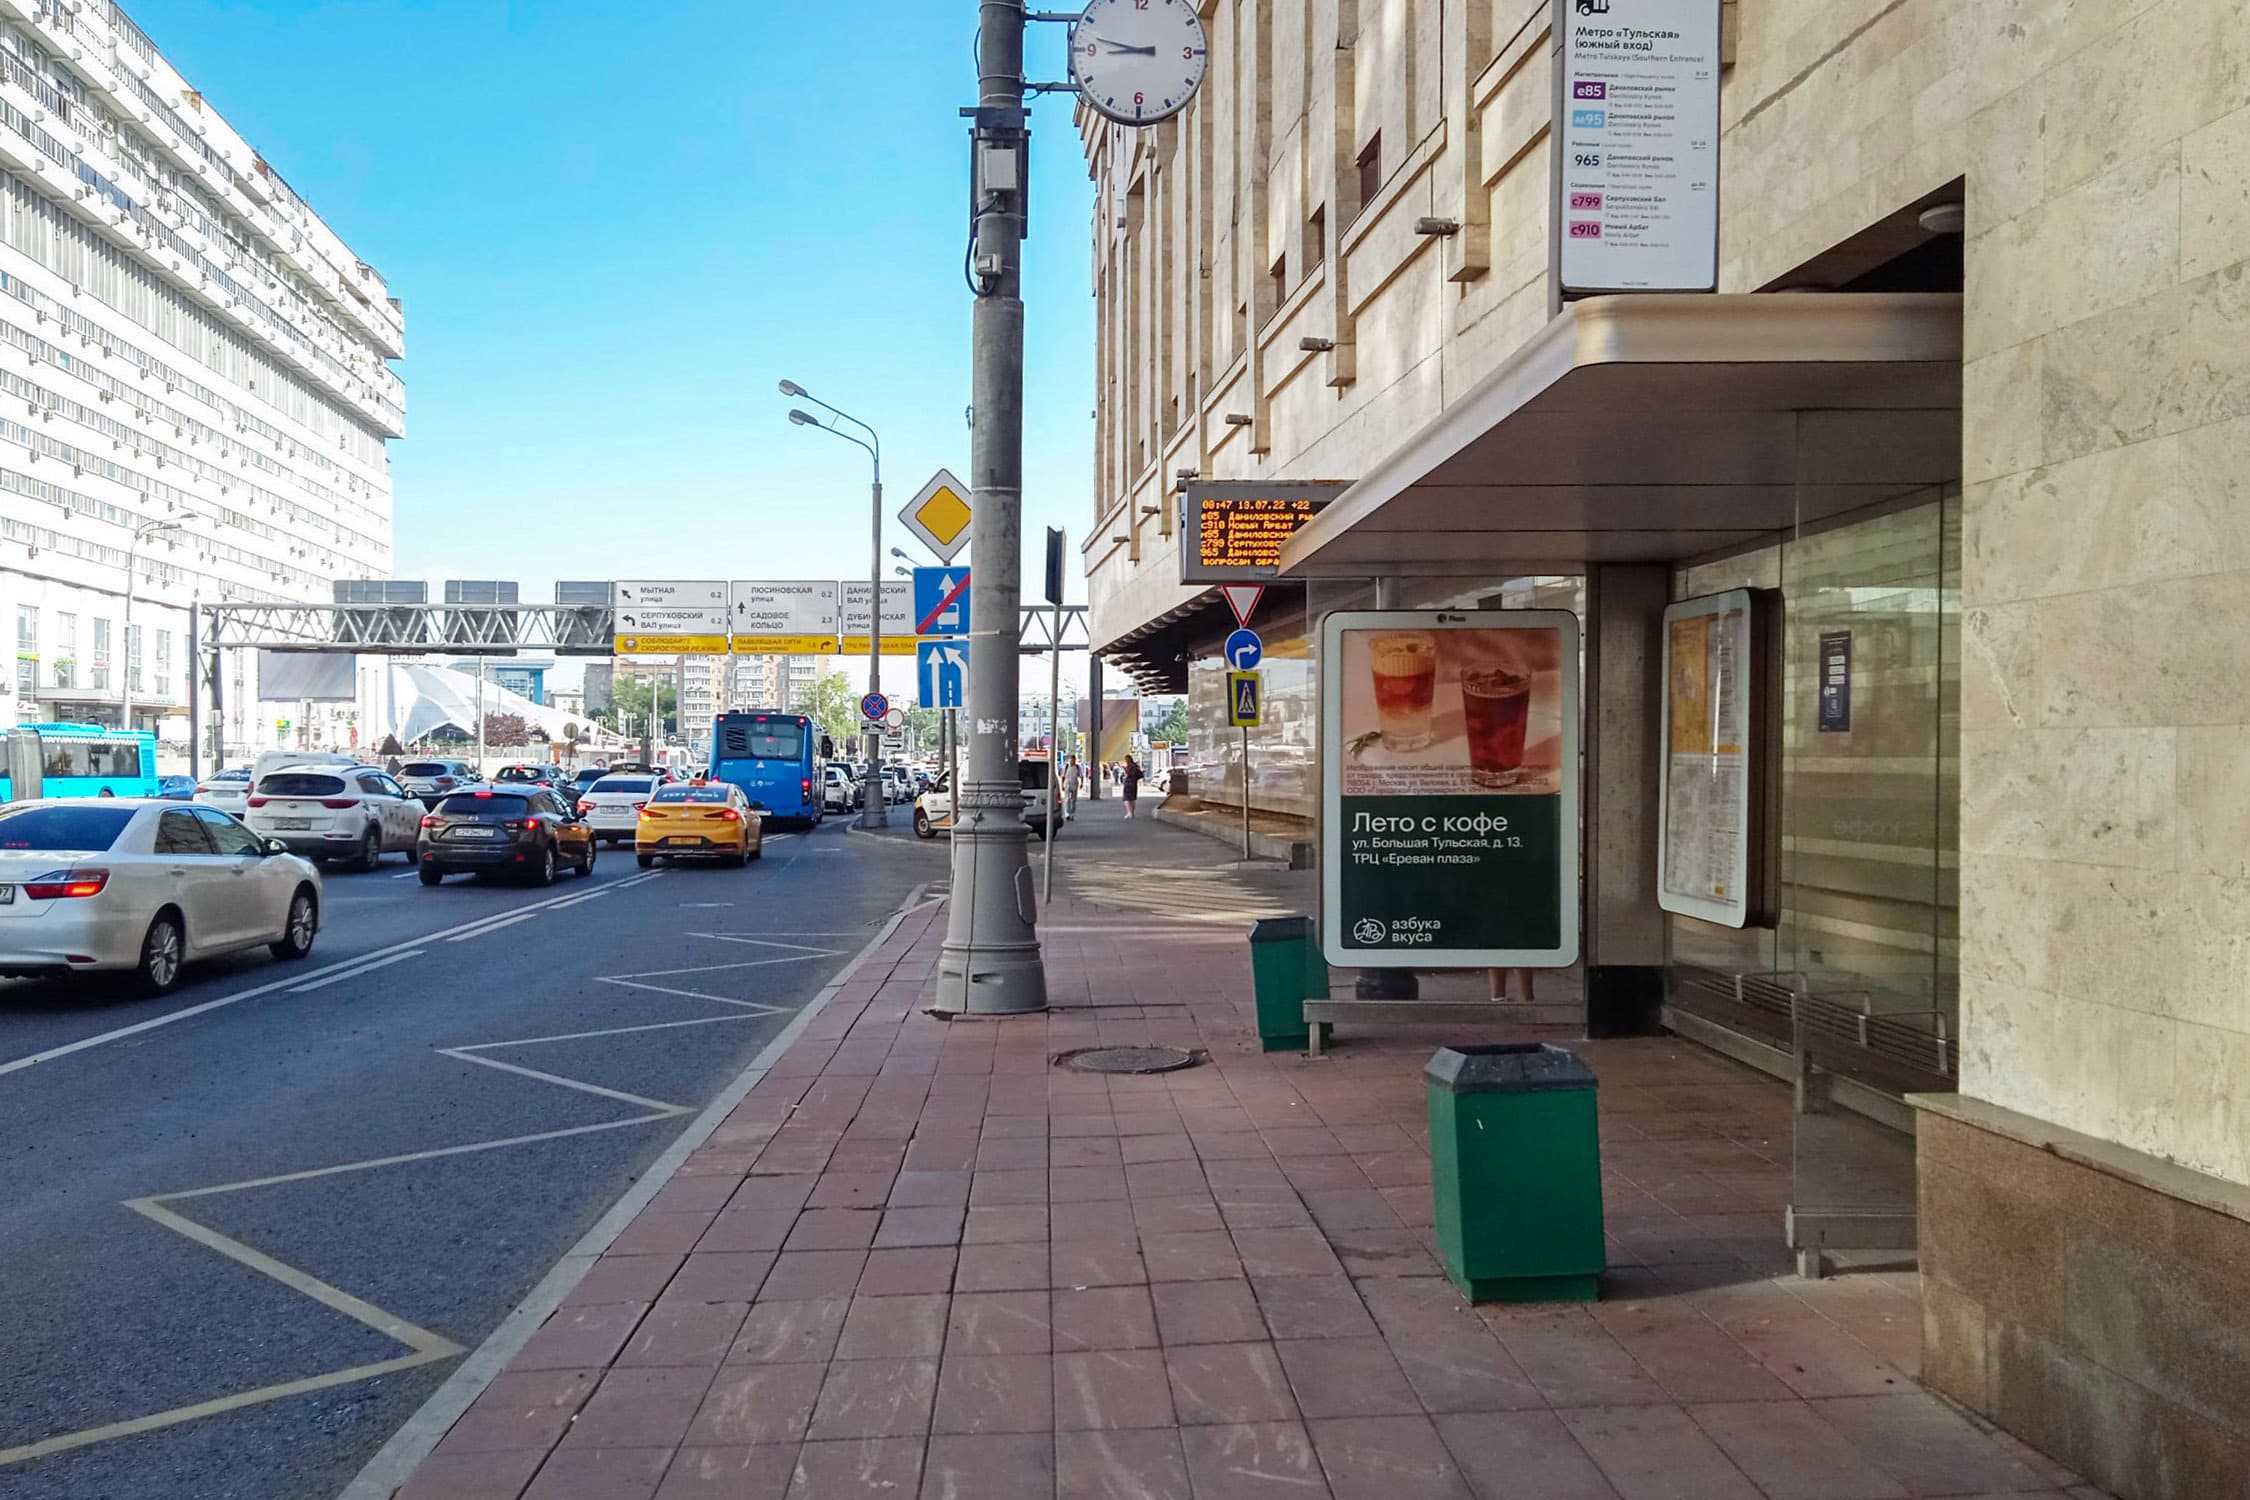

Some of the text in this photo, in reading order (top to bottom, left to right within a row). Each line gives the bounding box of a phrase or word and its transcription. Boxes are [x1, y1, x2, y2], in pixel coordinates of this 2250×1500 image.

[1576, 27, 1680, 40] Метро «Тульская»
[1087, 43, 1096, 56] 9
[1575, 38, 1653, 51] (южный вход)
[1183, 46, 1192, 60] 3
[1134, 92, 1144, 104] 6
[1575, 154, 1600, 166] 965
[1292, 501, 1310, 510] +22
[1352, 811, 1508, 836] Лето с кофе
[1353, 839, 1369, 850] ул.
[1372, 838, 1429, 848] Большая
[1353, 853, 1480, 865] ТРЦ «Ереван плаза»
[1392, 916, 1441, 932] азбука
[1392, 933, 1432, 944] вкуса
